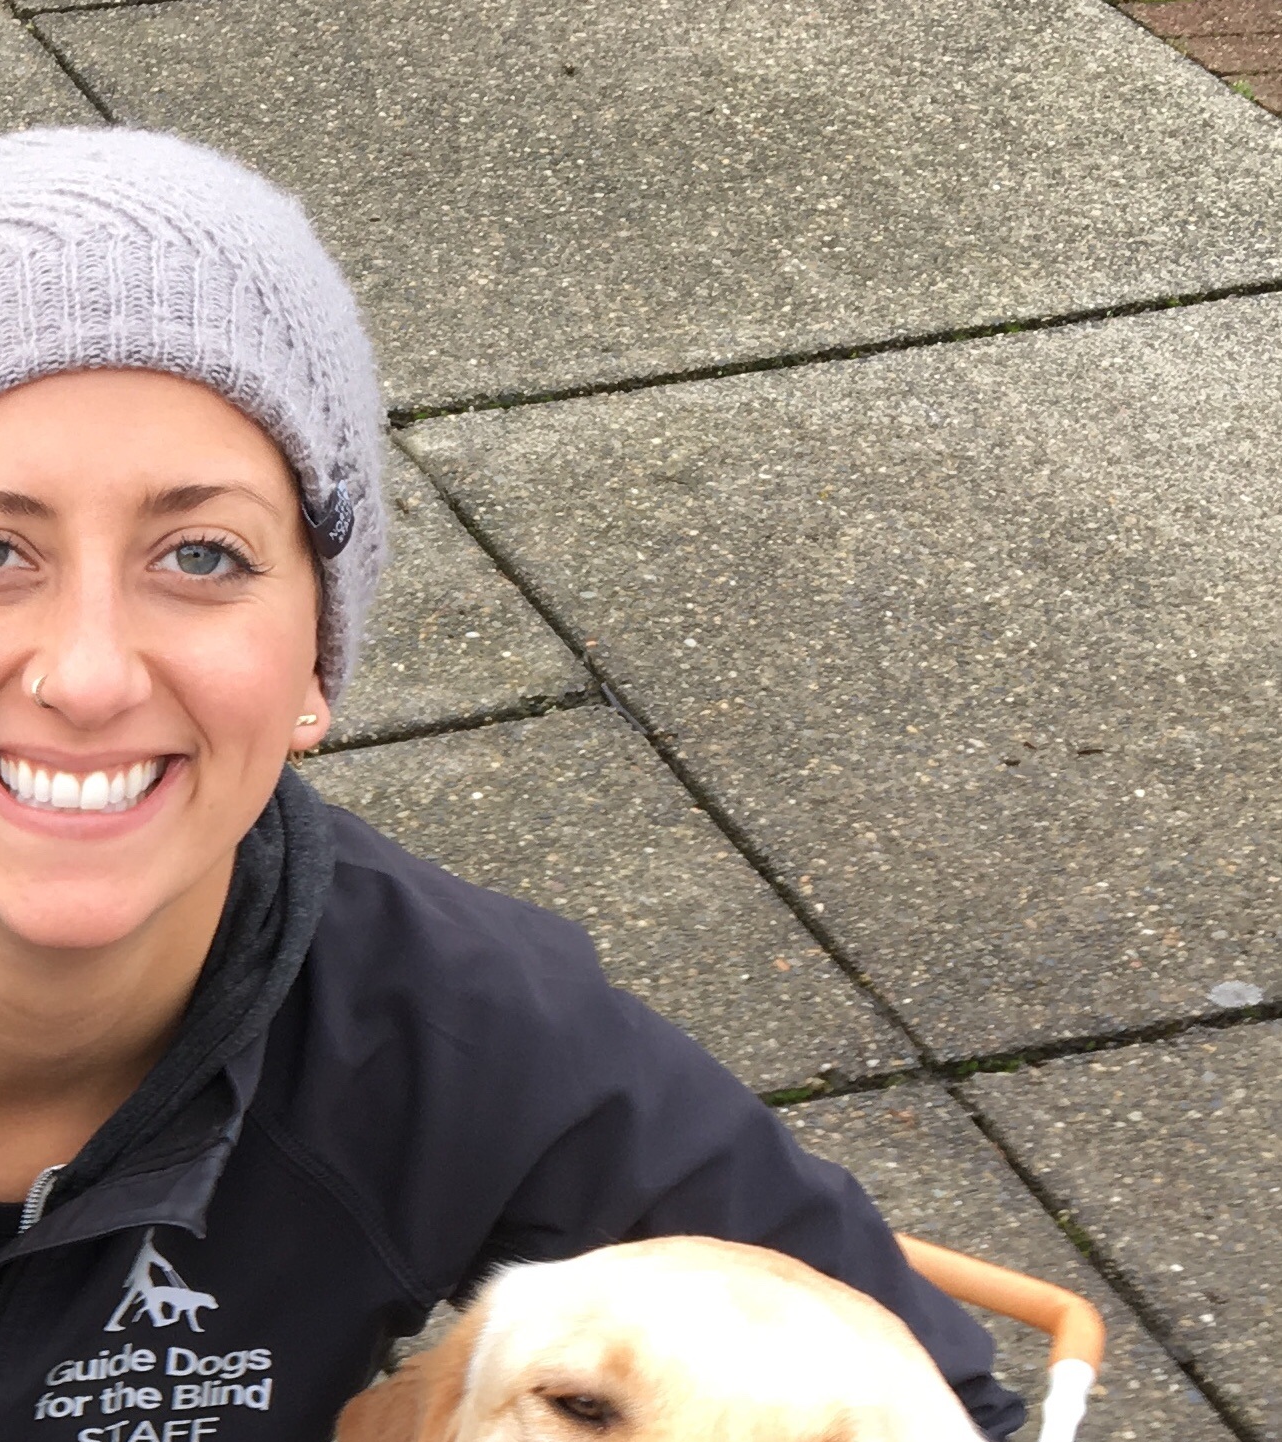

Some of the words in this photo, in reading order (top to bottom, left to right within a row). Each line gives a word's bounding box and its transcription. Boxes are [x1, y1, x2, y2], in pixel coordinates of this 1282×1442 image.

[45, 1343, 157, 1386] Guide
[165, 1346, 273, 1379] Dogs
[34, 1391, 93, 1421] for
[99, 1381, 163, 1415] the
[170, 1378, 273, 1411] Blind
